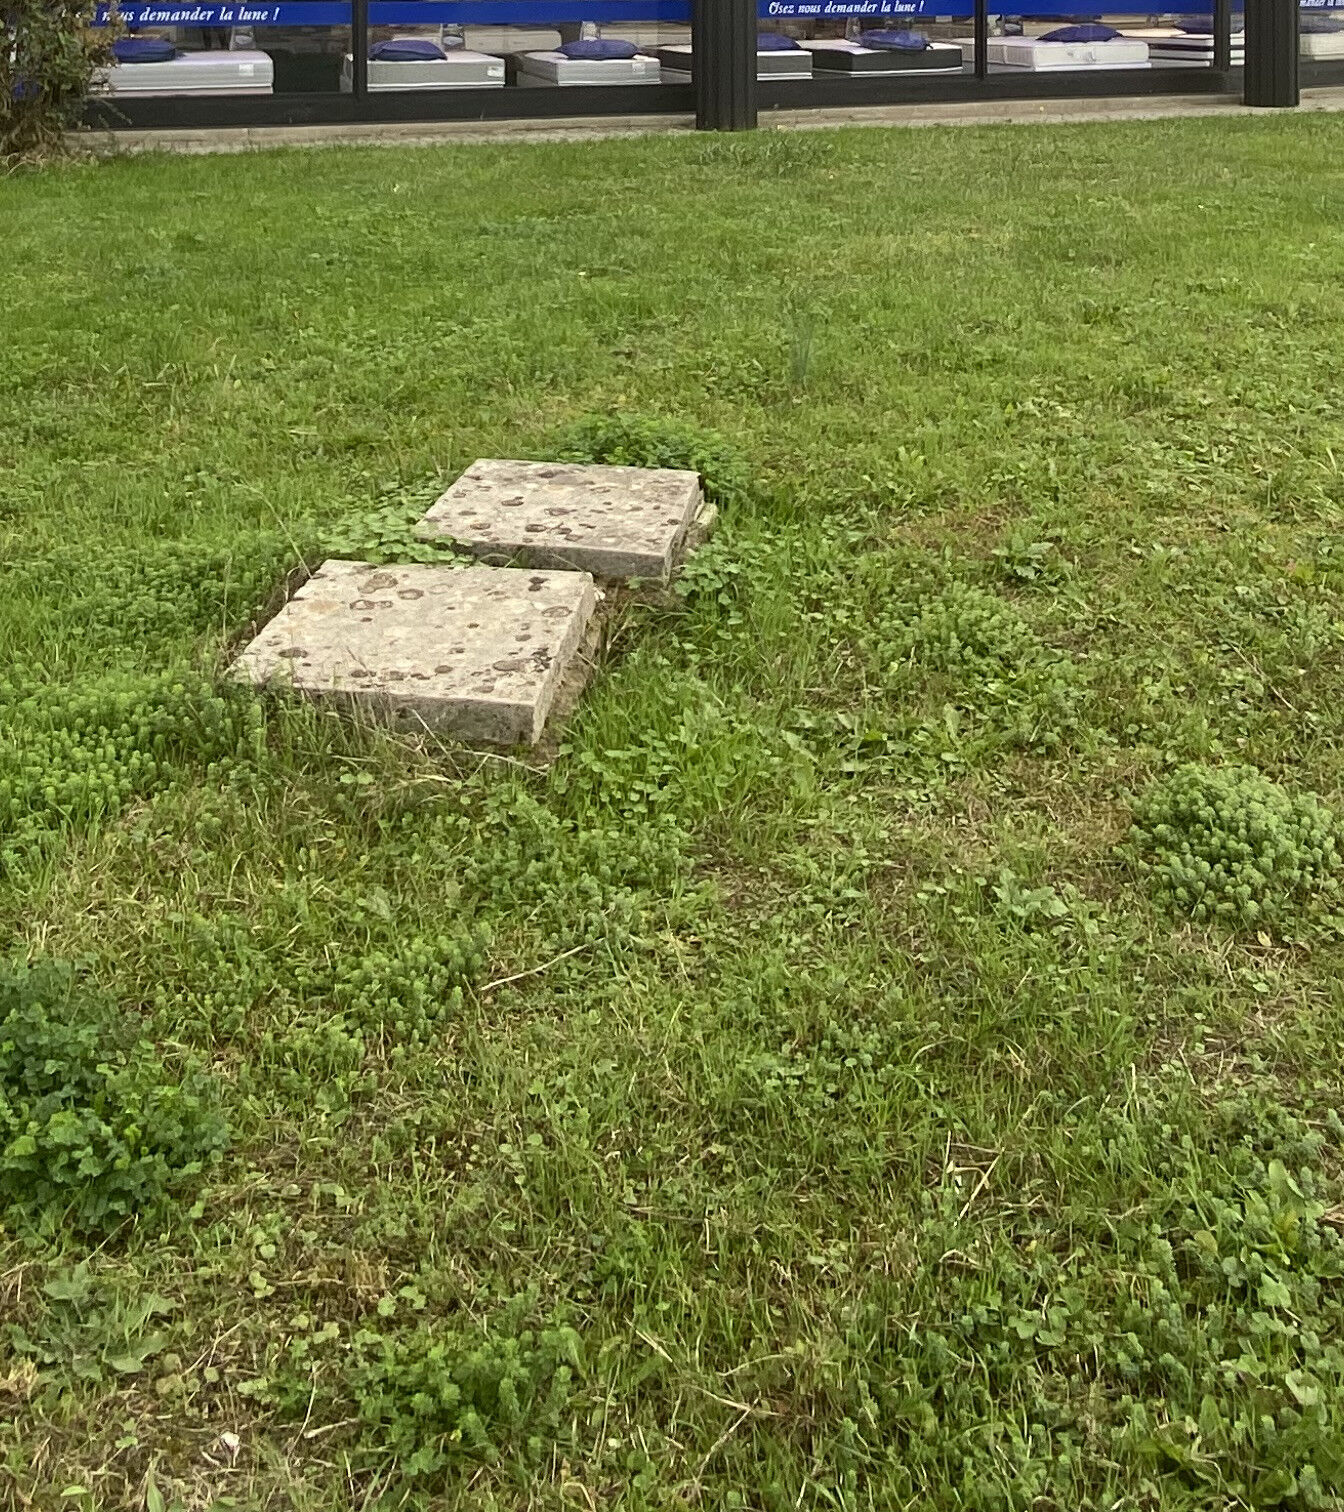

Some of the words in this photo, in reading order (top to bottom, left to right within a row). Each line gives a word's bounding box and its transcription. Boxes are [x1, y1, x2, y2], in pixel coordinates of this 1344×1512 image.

[139, 6, 215, 22] demander
[219, 6, 233, 21] la
[238, 6, 268, 21] lune
[768, 1, 795, 15] Osez
[798, 3, 821, 14] nous
[824, 1, 878, 14] demander
[881, 0, 892, 13] la
[894, 0, 916, 13] lune
